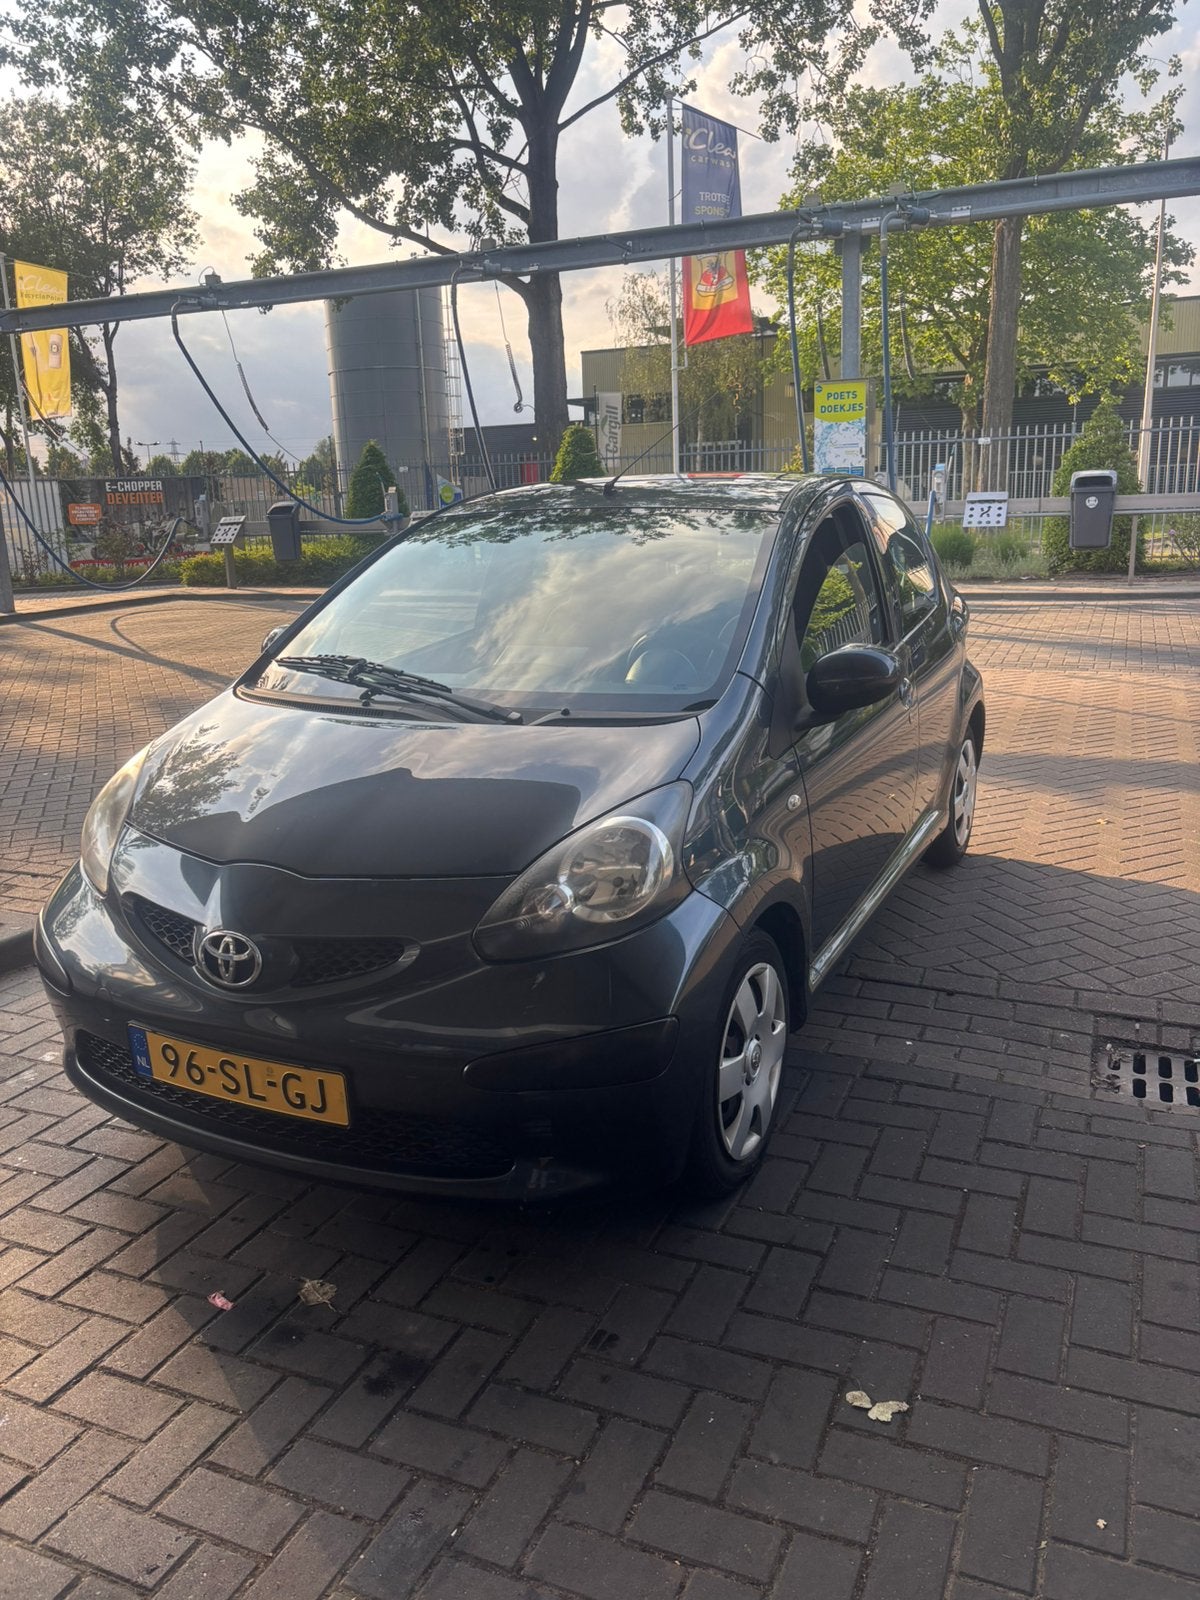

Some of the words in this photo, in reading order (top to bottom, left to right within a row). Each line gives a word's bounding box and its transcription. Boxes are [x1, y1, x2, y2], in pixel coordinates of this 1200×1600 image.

[826, 390, 858, 401] POETS
[820, 402, 864, 414] DOEKJES
[605, 404, 621, 454] Cargill
[105, 480, 163, 493] E-CHOPPER
[106, 492, 164, 505] DEVENTER
[136, 1054, 150, 1069] NL
[160, 1042, 328, 1114] 96-SL-GJ
